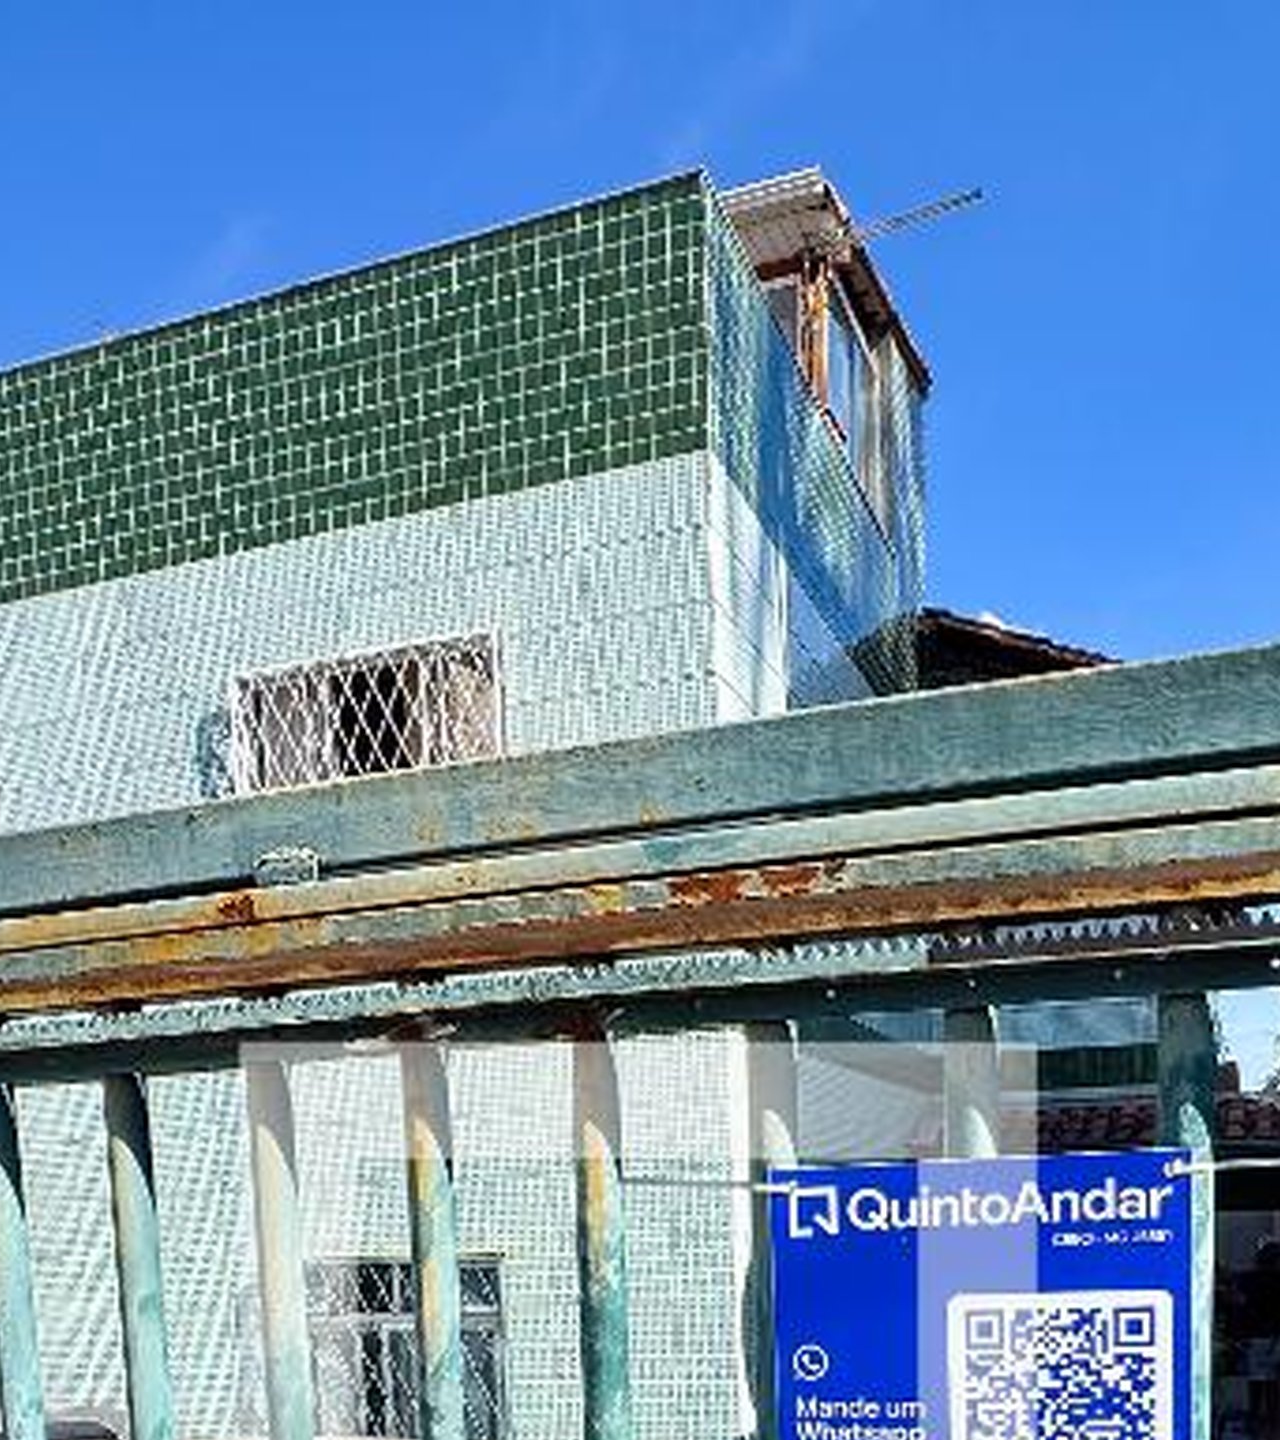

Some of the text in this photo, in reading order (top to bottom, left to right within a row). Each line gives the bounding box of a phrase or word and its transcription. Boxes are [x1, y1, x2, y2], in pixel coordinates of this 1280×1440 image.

[846, 1177, 1173, 1231] QuintoAndar
[796, 1394, 927, 1419] Mande um
